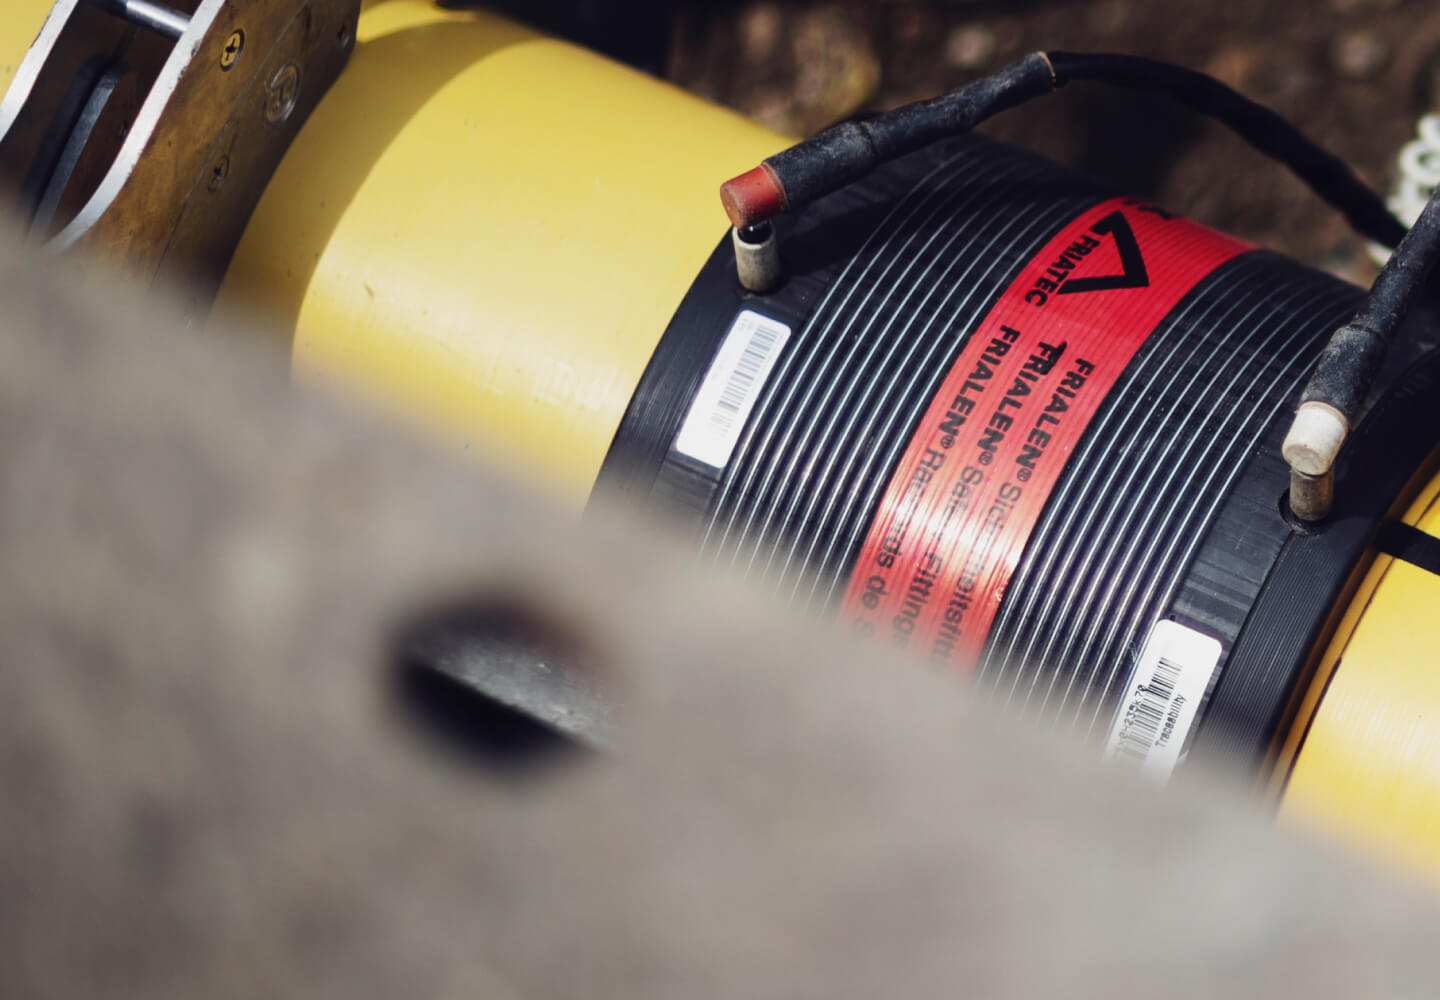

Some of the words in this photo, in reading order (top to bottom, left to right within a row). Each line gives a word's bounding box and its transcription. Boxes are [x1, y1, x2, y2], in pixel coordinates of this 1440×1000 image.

[1024, 225, 1100, 307] FRIATEC
[938, 325, 1021, 450] FRIALEN®
[977, 341, 1064, 466] FRIALEN®
[1015, 358, 1096, 482] FRIALEN®
[861, 575, 887, 610] de
[1154, 694, 1187, 748] Traceability
